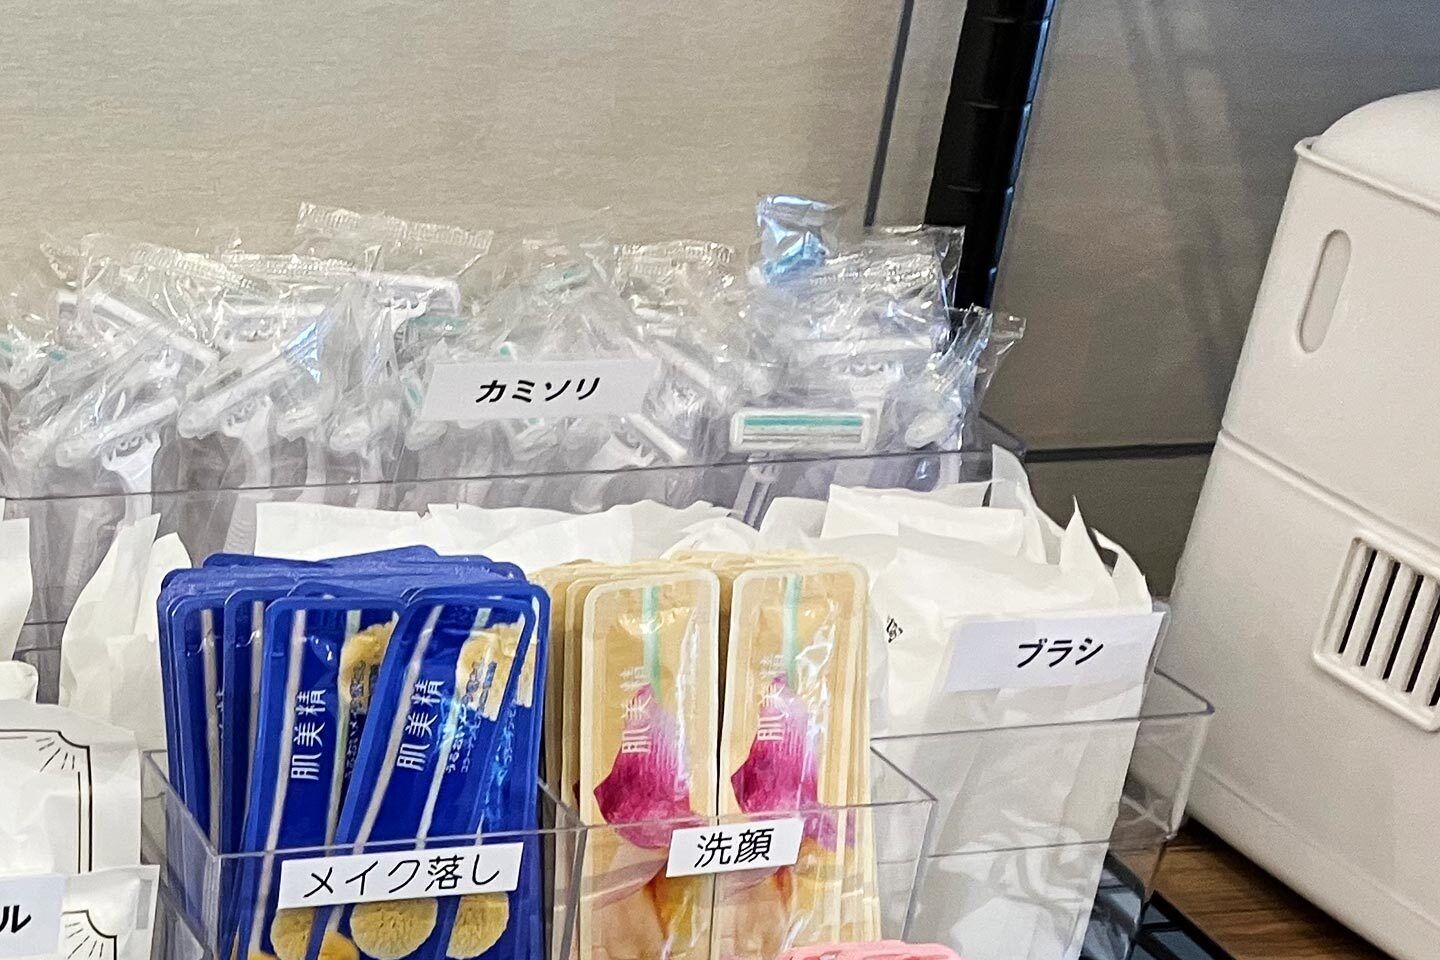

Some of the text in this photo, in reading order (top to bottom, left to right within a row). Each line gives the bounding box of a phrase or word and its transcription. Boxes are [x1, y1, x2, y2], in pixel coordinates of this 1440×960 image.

[475, 376, 601, 404] カミソリ
[1016, 637, 1105, 668] ブラシ
[291, 689, 327, 781] 肌美精
[396, 680, 443, 771] 肌美精
[694, 829, 773, 867] 洗顔
[303, 853, 500, 898] メイク落し
